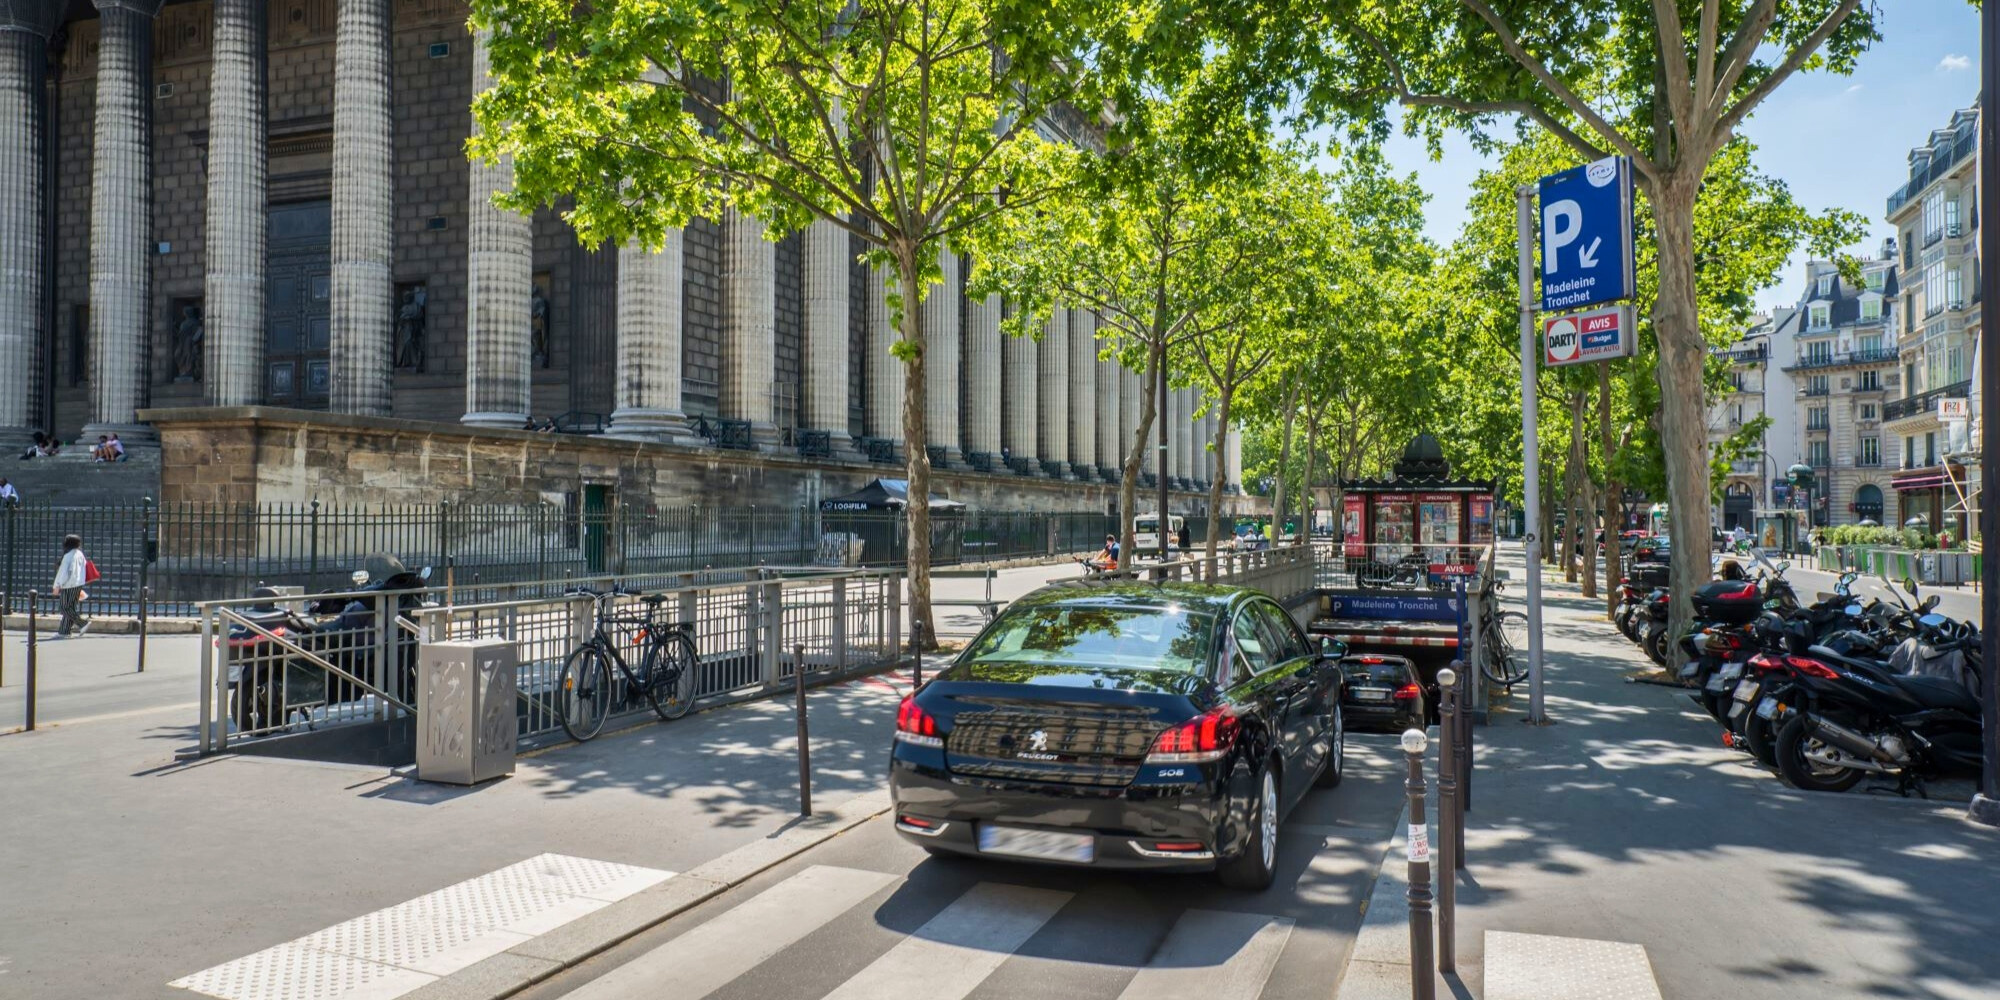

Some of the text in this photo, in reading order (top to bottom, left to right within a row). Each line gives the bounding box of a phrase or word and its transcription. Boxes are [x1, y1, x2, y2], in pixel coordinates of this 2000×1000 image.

[1544, 199, 1582, 275] P
[1546, 276, 1596, 296] Madeleine
[1546, 290, 1590, 308] Tronchet
[1588, 317, 1610, 330] AVIS
[1549, 332, 1577, 349] DARTY
[1593, 334, 1612, 343] Budget
[1580, 344, 1620, 356] LAVAGE AUTO
[1444, 565, 1464, 573] AVIS
[1334, 600, 1438, 612] P Madeleine Tronchet
[1017, 752, 1059, 761] PEUGEOT
[1158, 768, 1184, 777] 508
